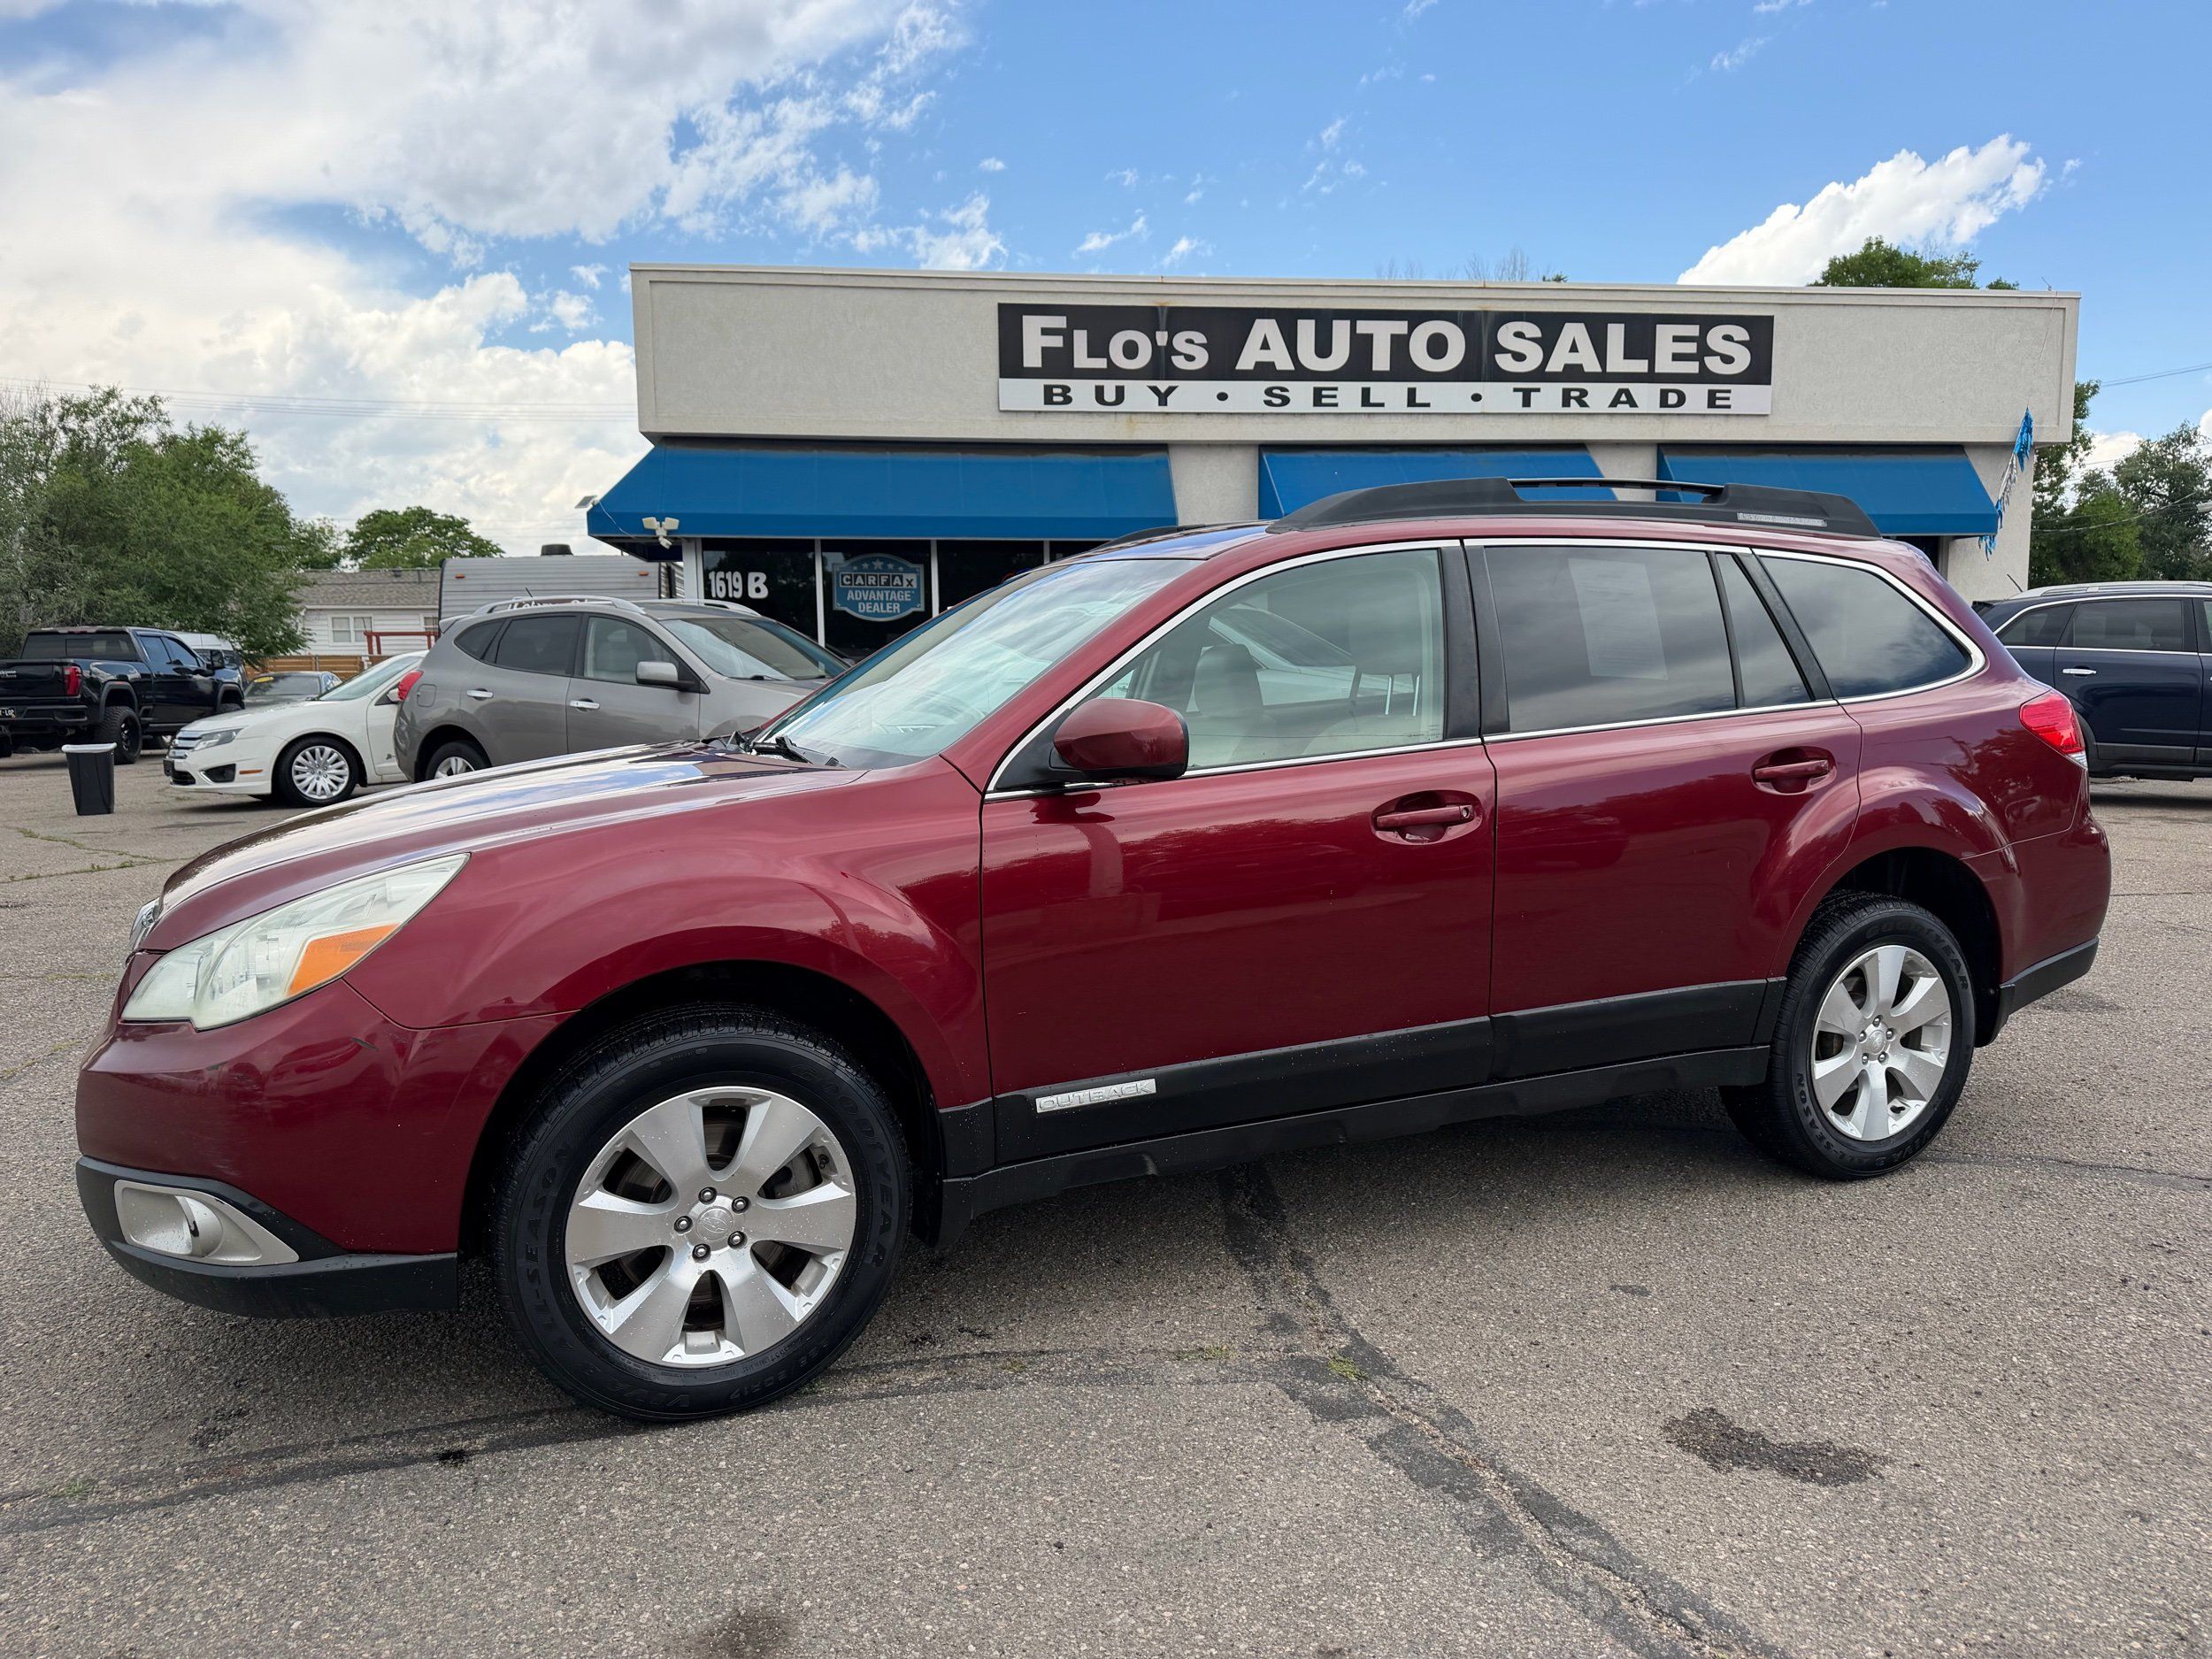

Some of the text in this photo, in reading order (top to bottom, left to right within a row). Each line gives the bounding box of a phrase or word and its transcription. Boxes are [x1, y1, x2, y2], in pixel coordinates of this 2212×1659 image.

[1235, 319, 1466, 373] AUTO
[1494, 321, 1751, 375] SALES
[1043, 384, 1732, 409] BUY SELL TRADE
[709, 571, 768, 599] 1619 B
[841, 574, 914, 588] CARFAX
[847, 590, 911, 601] ADVANTAGE
[858, 603, 901, 613] DEALER
[1039, 1080, 1154, 1111] OUTBACK
[791, 1063, 893, 1268] GOODYEAR
